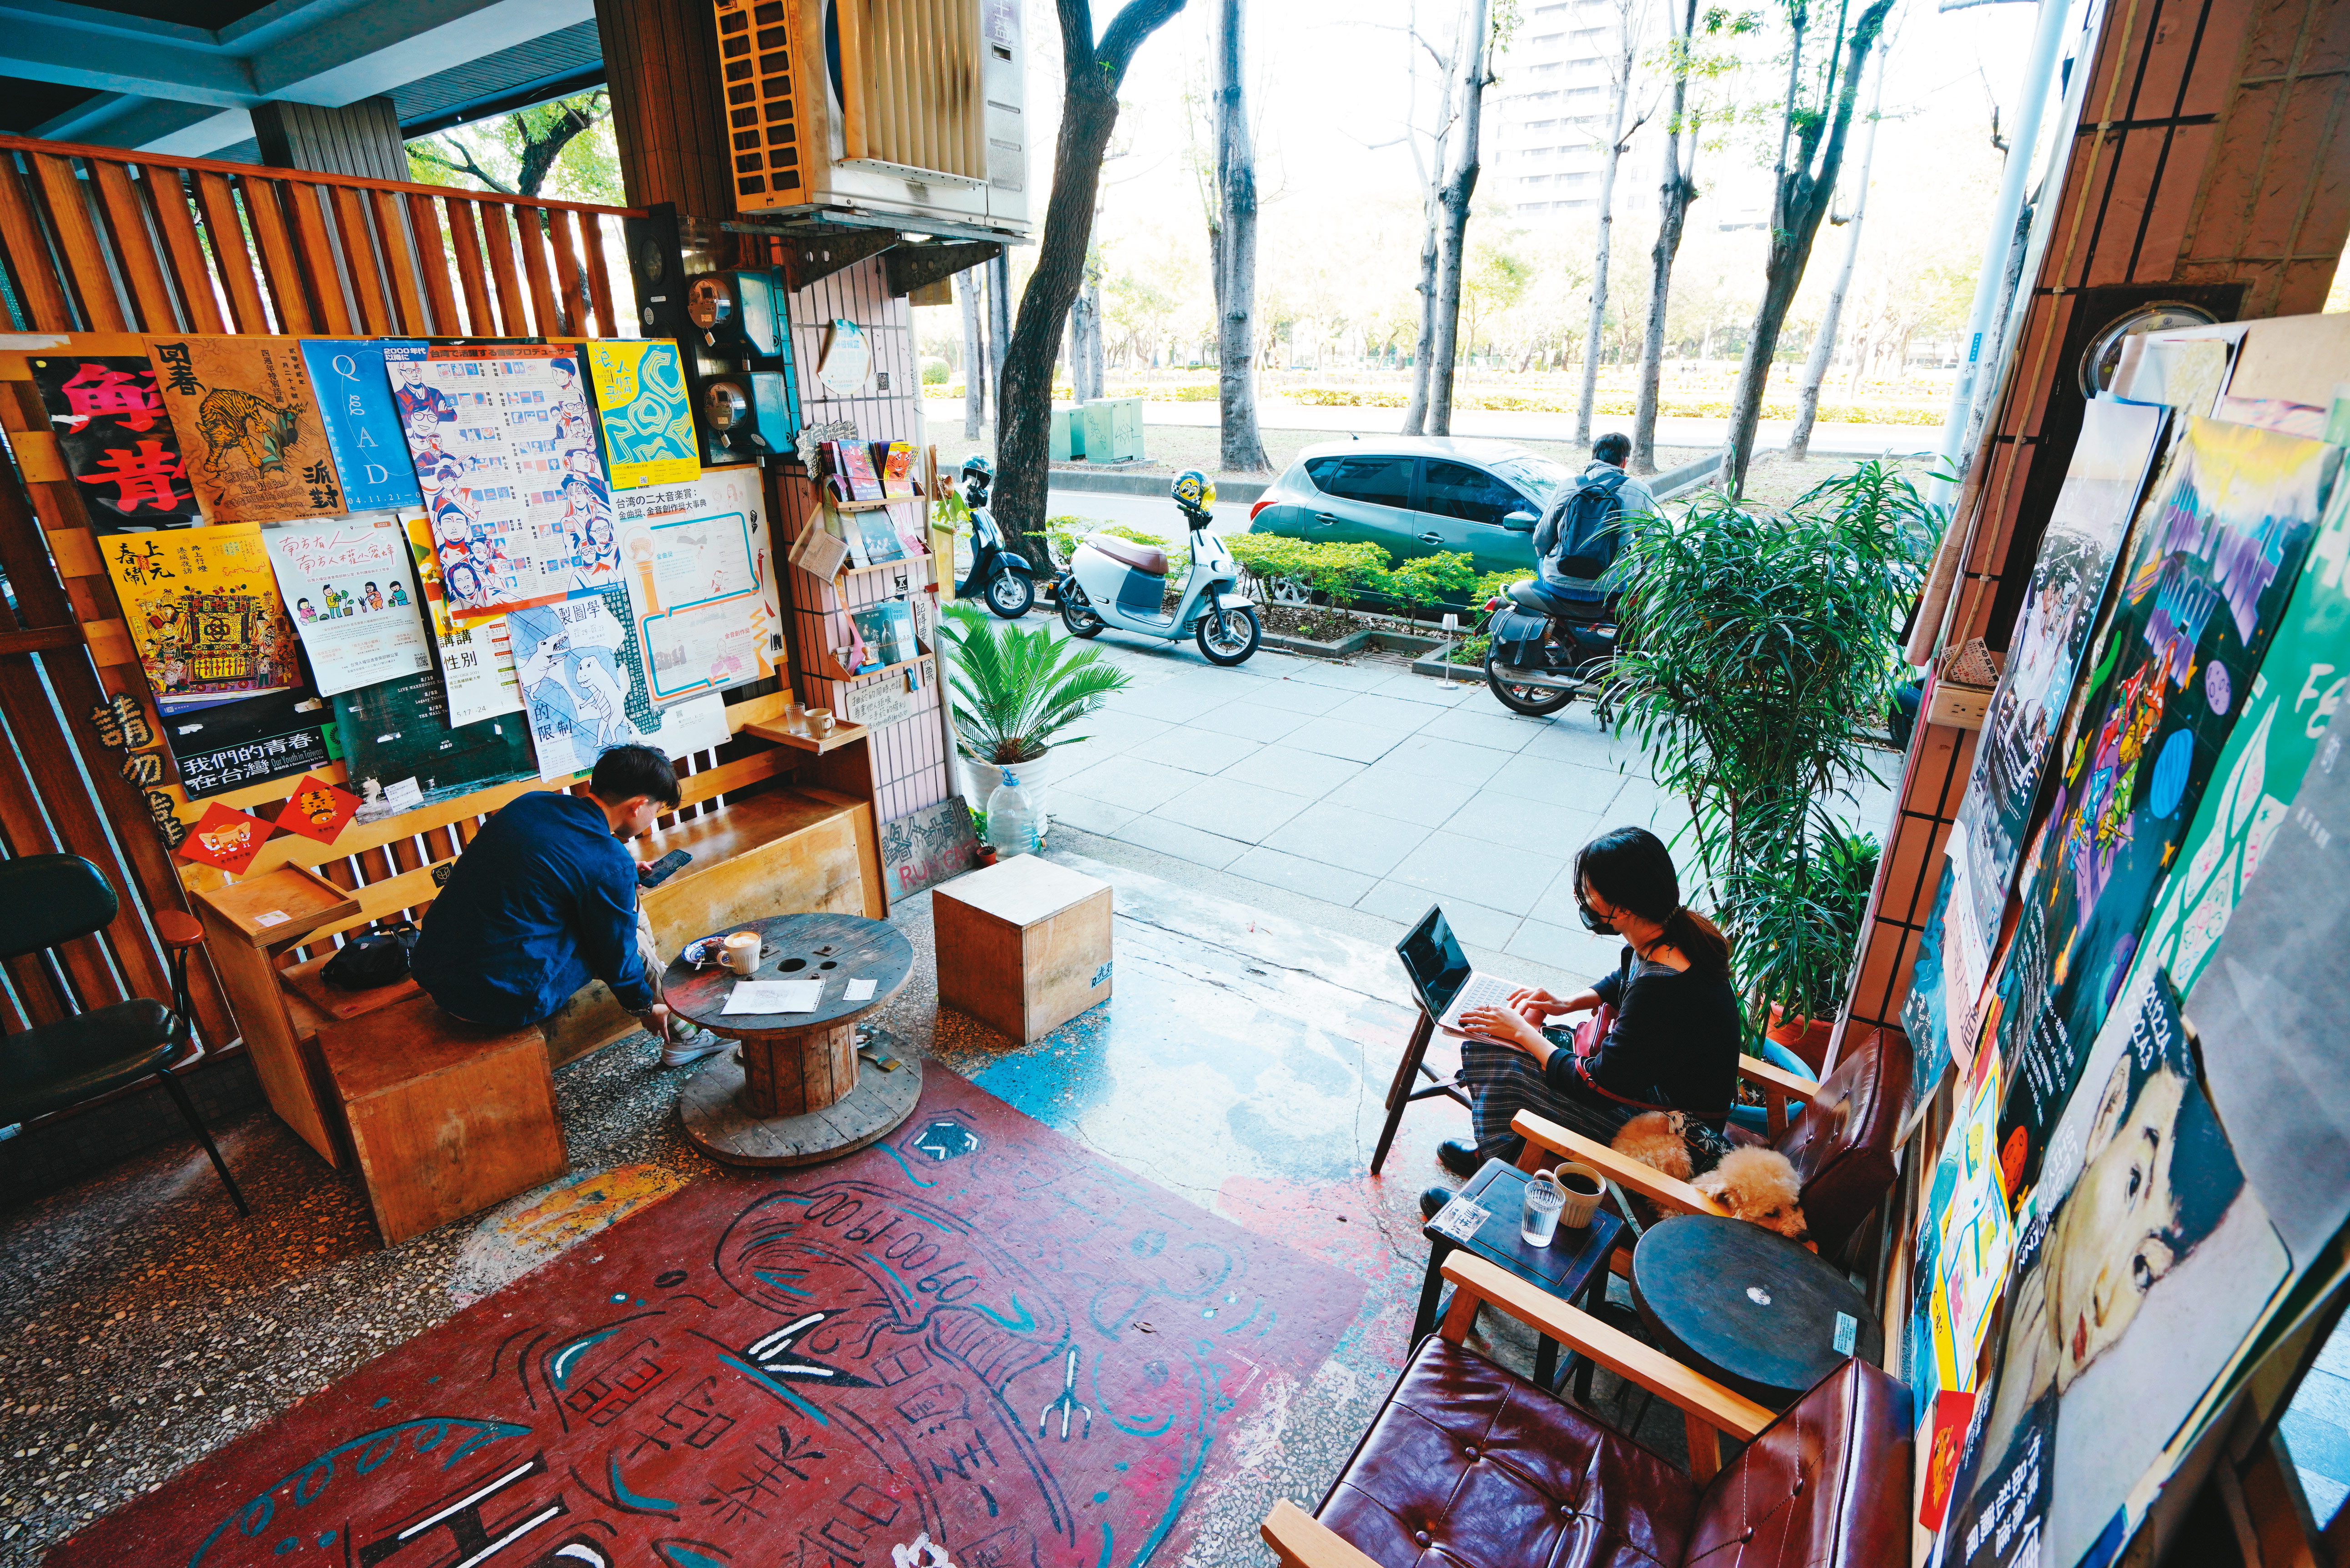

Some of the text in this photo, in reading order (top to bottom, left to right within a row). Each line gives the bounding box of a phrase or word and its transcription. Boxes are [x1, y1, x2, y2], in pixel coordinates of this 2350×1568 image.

[154, 342, 206, 395] 回春
[332, 355, 361, 381] Q
[357, 427, 378, 447] A
[302, 459, 339, 508] 派對
[363, 464, 388, 484] D
[558, 599, 600, 625] 製圖學
[443, 651, 478, 671] 性別
[409, 680, 437, 690] WAREHOUSE
[534, 703, 549, 722] 的
[537, 719, 573, 743] 限制
[271, 757, 282, 767] Our
[282, 753, 298, 766] Youth
[303, 748, 323, 760] Taiwan
